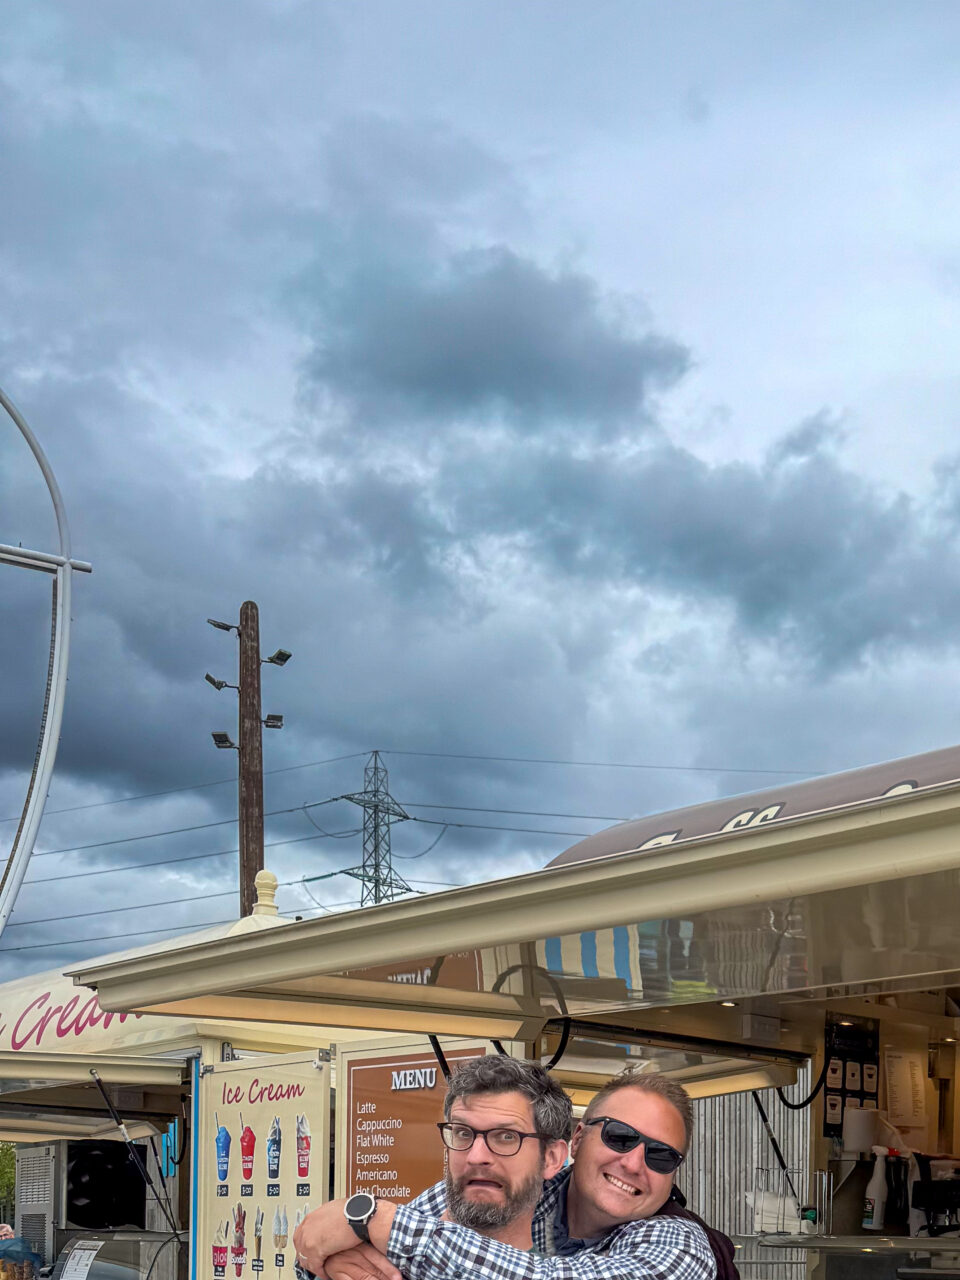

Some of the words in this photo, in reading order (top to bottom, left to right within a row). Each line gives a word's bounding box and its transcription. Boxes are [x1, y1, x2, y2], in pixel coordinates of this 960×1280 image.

[391, 1068, 437, 1090] MENU
[222, 1081, 244, 1105] Ice
[248, 1079, 305, 1104] Cream
[356, 1102, 377, 1114] Latte
[356, 1117, 402, 1133] Cappuccino
[356, 1135, 370, 1147] Flat
[372, 1134, 395, 1147] White
[356, 1152, 389, 1166] Espresso
[356, 1168, 398, 1181] Americano
[371, 1185, 411, 1198] Chocolate
